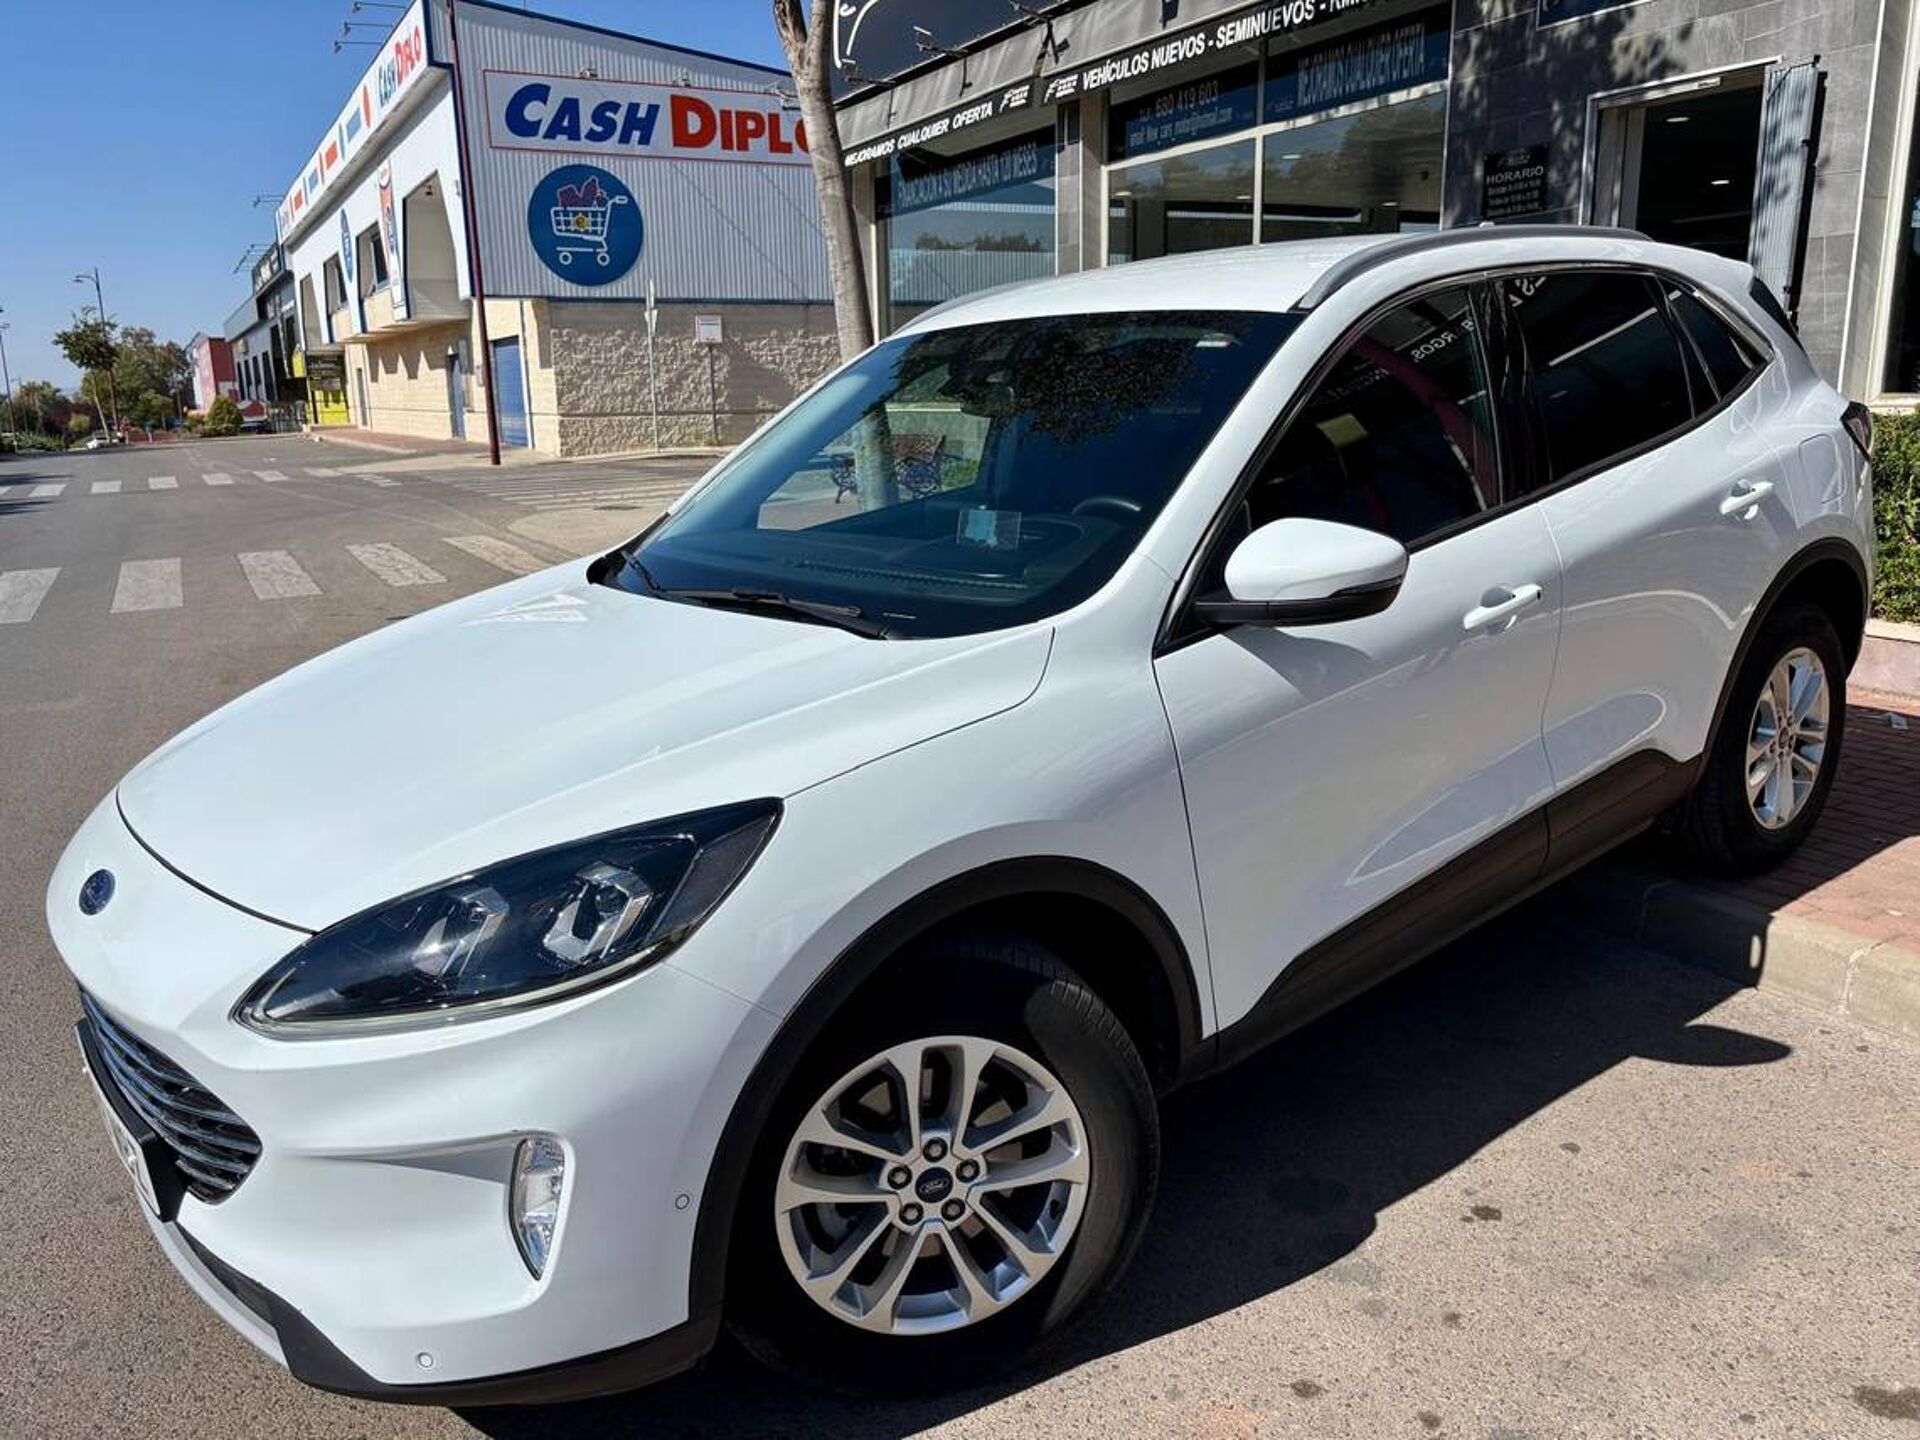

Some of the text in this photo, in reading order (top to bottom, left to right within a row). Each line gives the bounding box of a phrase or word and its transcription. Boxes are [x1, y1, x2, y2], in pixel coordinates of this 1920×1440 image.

[1082, 51, 1150, 92] VEHÍCULOS
[1151, 32, 1205, 69] NUEVOS
[1216, 0, 1316, 49] SEMINUEVOS
[504, 83, 660, 146] CASH
[897, 117, 950, 150] CUALQUIER
[952, 100, 993, 129] OFERTA
[1486, 165, 1544, 185] HORARIO
